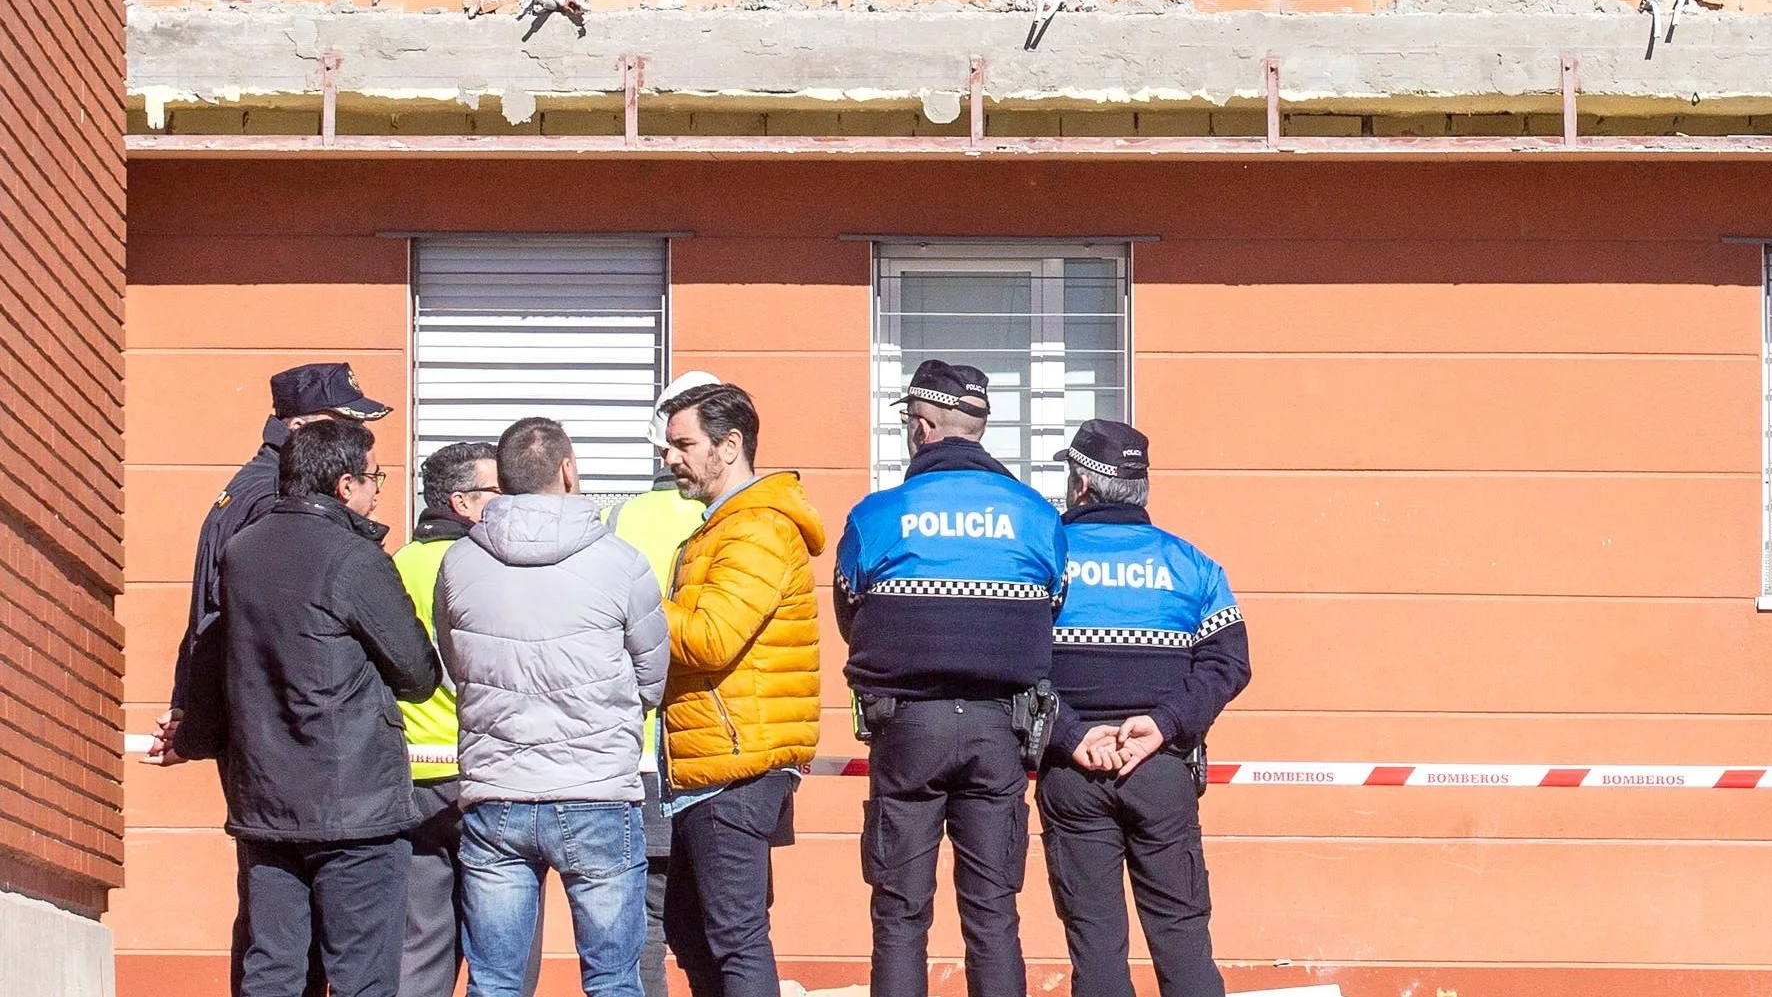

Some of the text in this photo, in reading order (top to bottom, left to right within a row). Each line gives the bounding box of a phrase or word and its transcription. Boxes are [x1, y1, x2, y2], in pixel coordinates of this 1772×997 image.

[901, 507, 1015, 540] POLICÍA
[1068, 558, 1174, 591] POLICÍA
[1252, 771, 1334, 782] BOMBEROS
[1427, 773, 1509, 784] BOMBEROS
[1602, 775, 1685, 785] BOMBEROS
